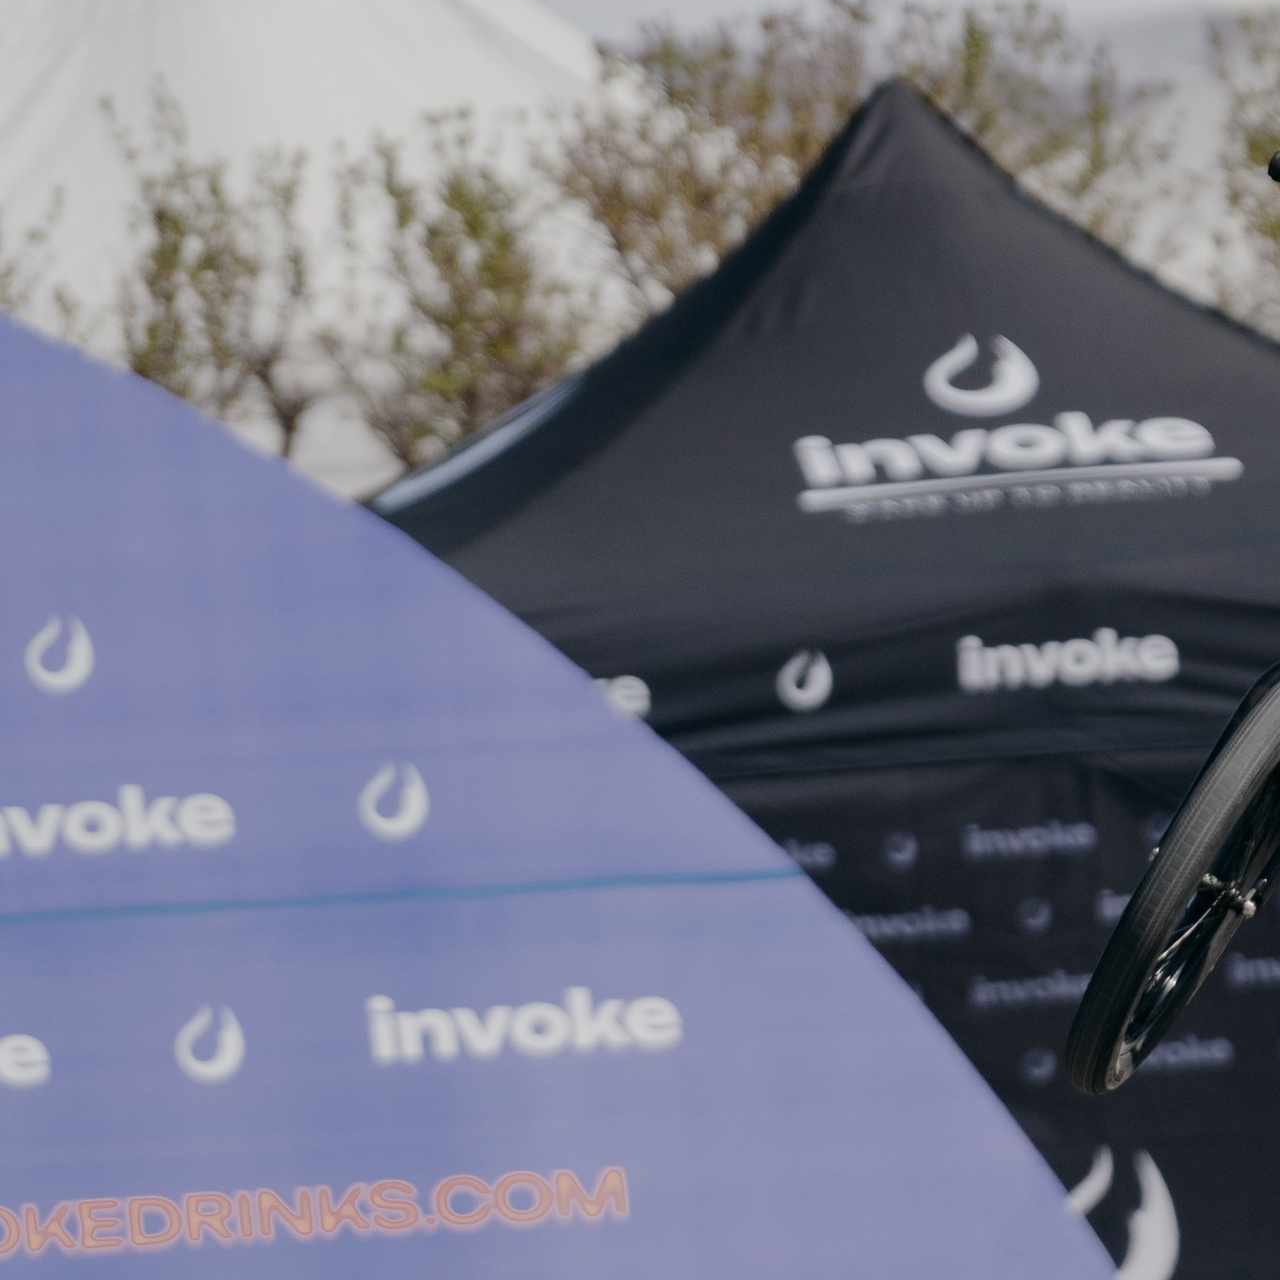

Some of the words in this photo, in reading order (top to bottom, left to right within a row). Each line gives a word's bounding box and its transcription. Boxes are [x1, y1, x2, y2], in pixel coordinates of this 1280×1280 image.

[794, 410, 1215, 488] invoke
[956, 627, 1181, 692] invoke
[0, 782, 236, 860] voke
[365, 985, 684, 1065] invoke
